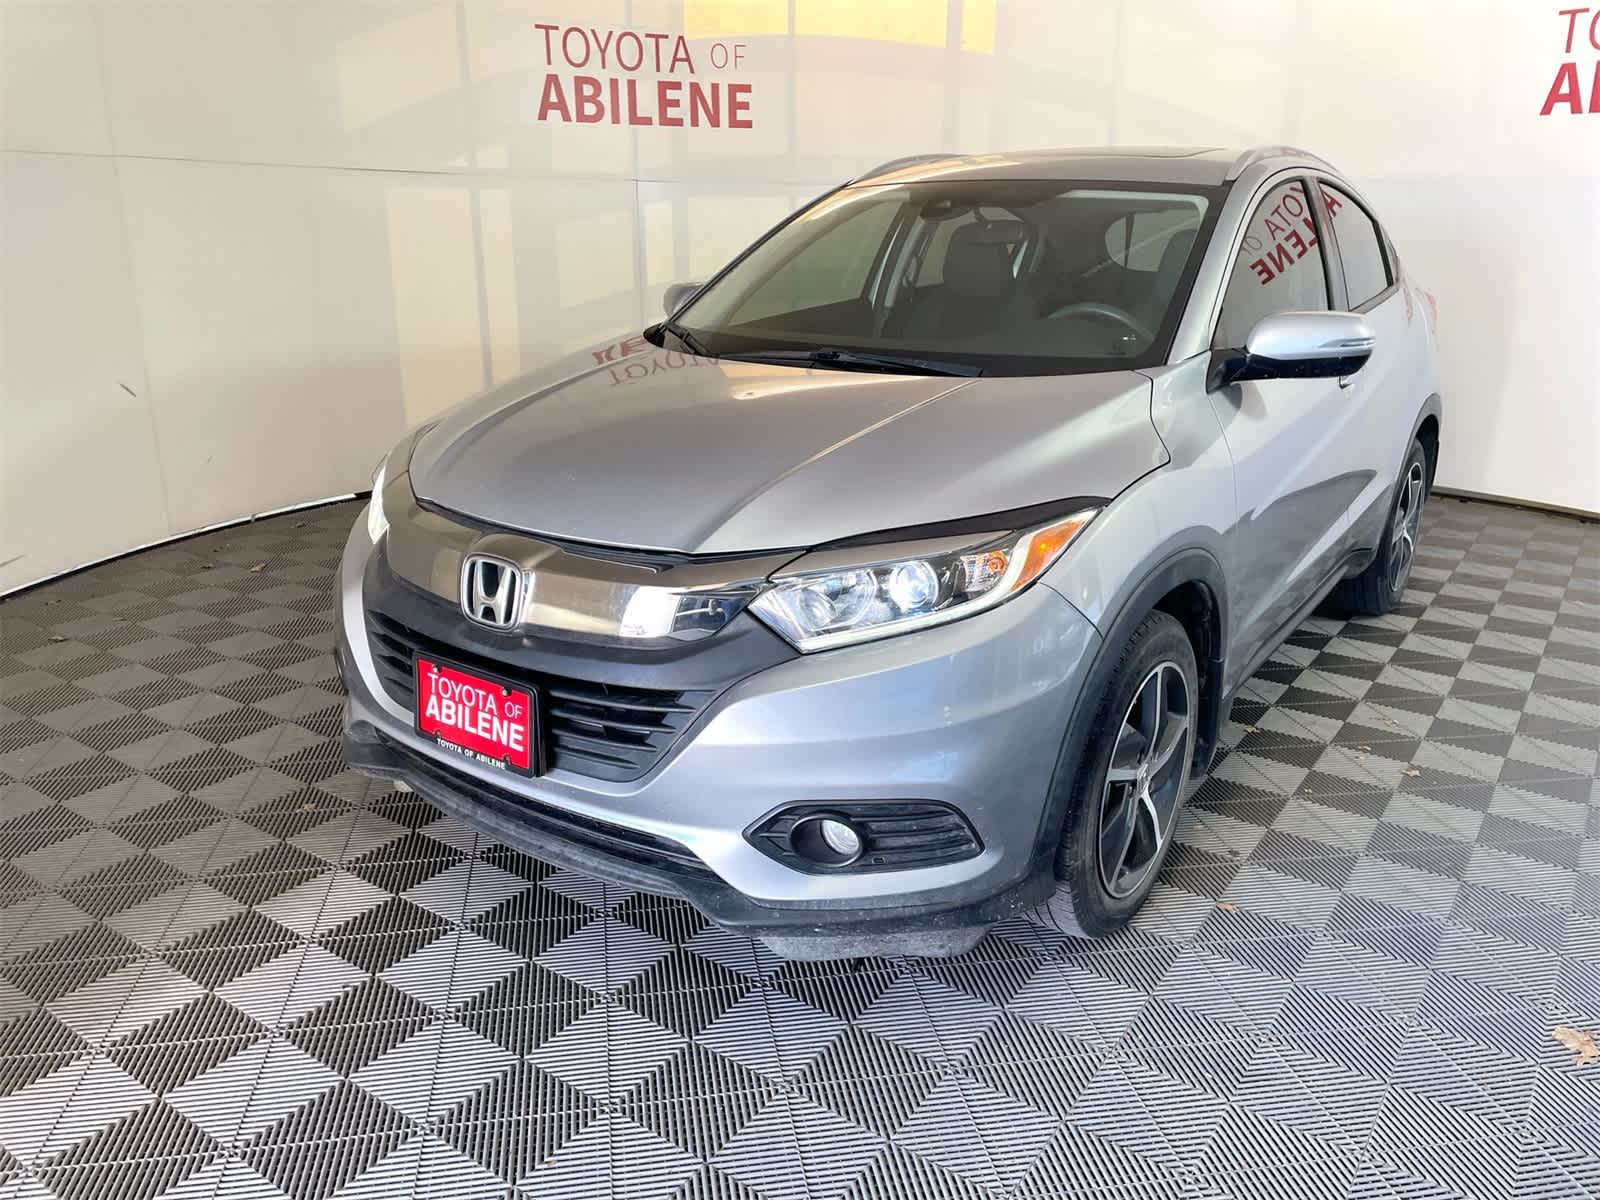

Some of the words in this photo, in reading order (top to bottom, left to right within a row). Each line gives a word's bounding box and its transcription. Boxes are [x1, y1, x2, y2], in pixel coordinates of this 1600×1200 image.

[534, 24, 695, 74] TOYOTA
[710, 43, 746, 71] OF
[537, 73, 753, 129] ABILENE
[427, 672, 498, 715] TOYOTA
[504, 701, 523, 719] OF
[425, 694, 525, 752] ABILENE
[437, 738, 462, 753] TOYOTA
[464, 749, 474, 760] OF
[476, 753, 505, 770] ABILENE
